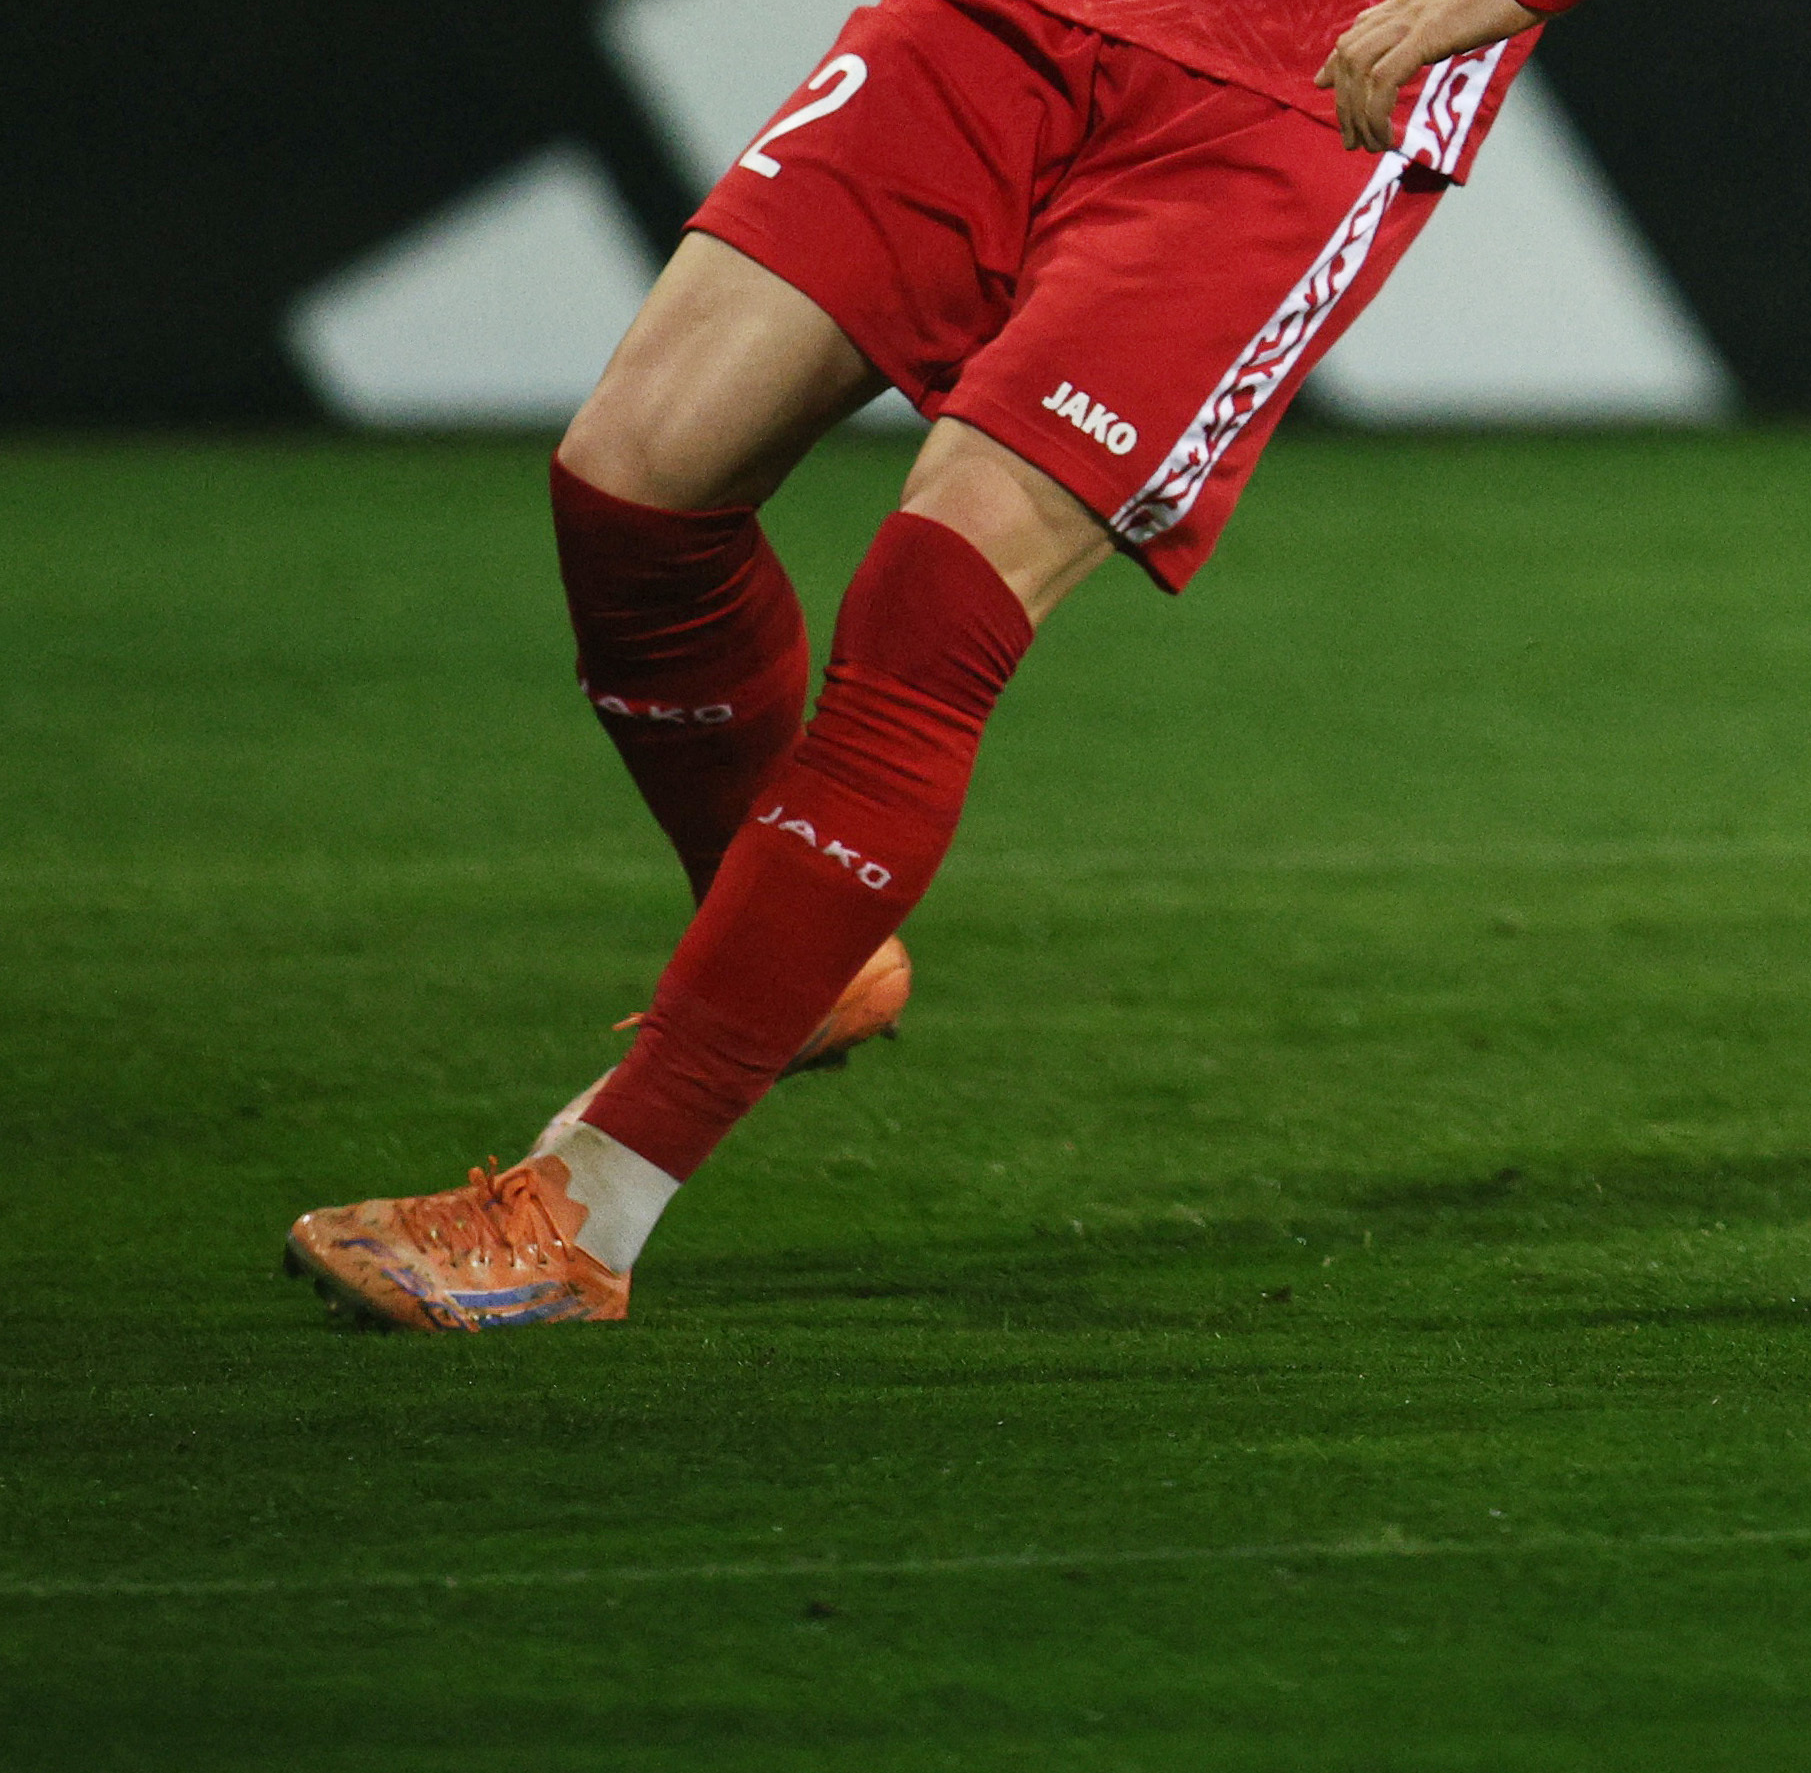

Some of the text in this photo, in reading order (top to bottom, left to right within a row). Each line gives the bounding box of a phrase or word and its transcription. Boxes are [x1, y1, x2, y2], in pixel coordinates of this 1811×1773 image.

[737, 53, 869, 180] 2
[1041, 381, 1139, 457] JAKO
[756, 806, 892, 890] JAKO
